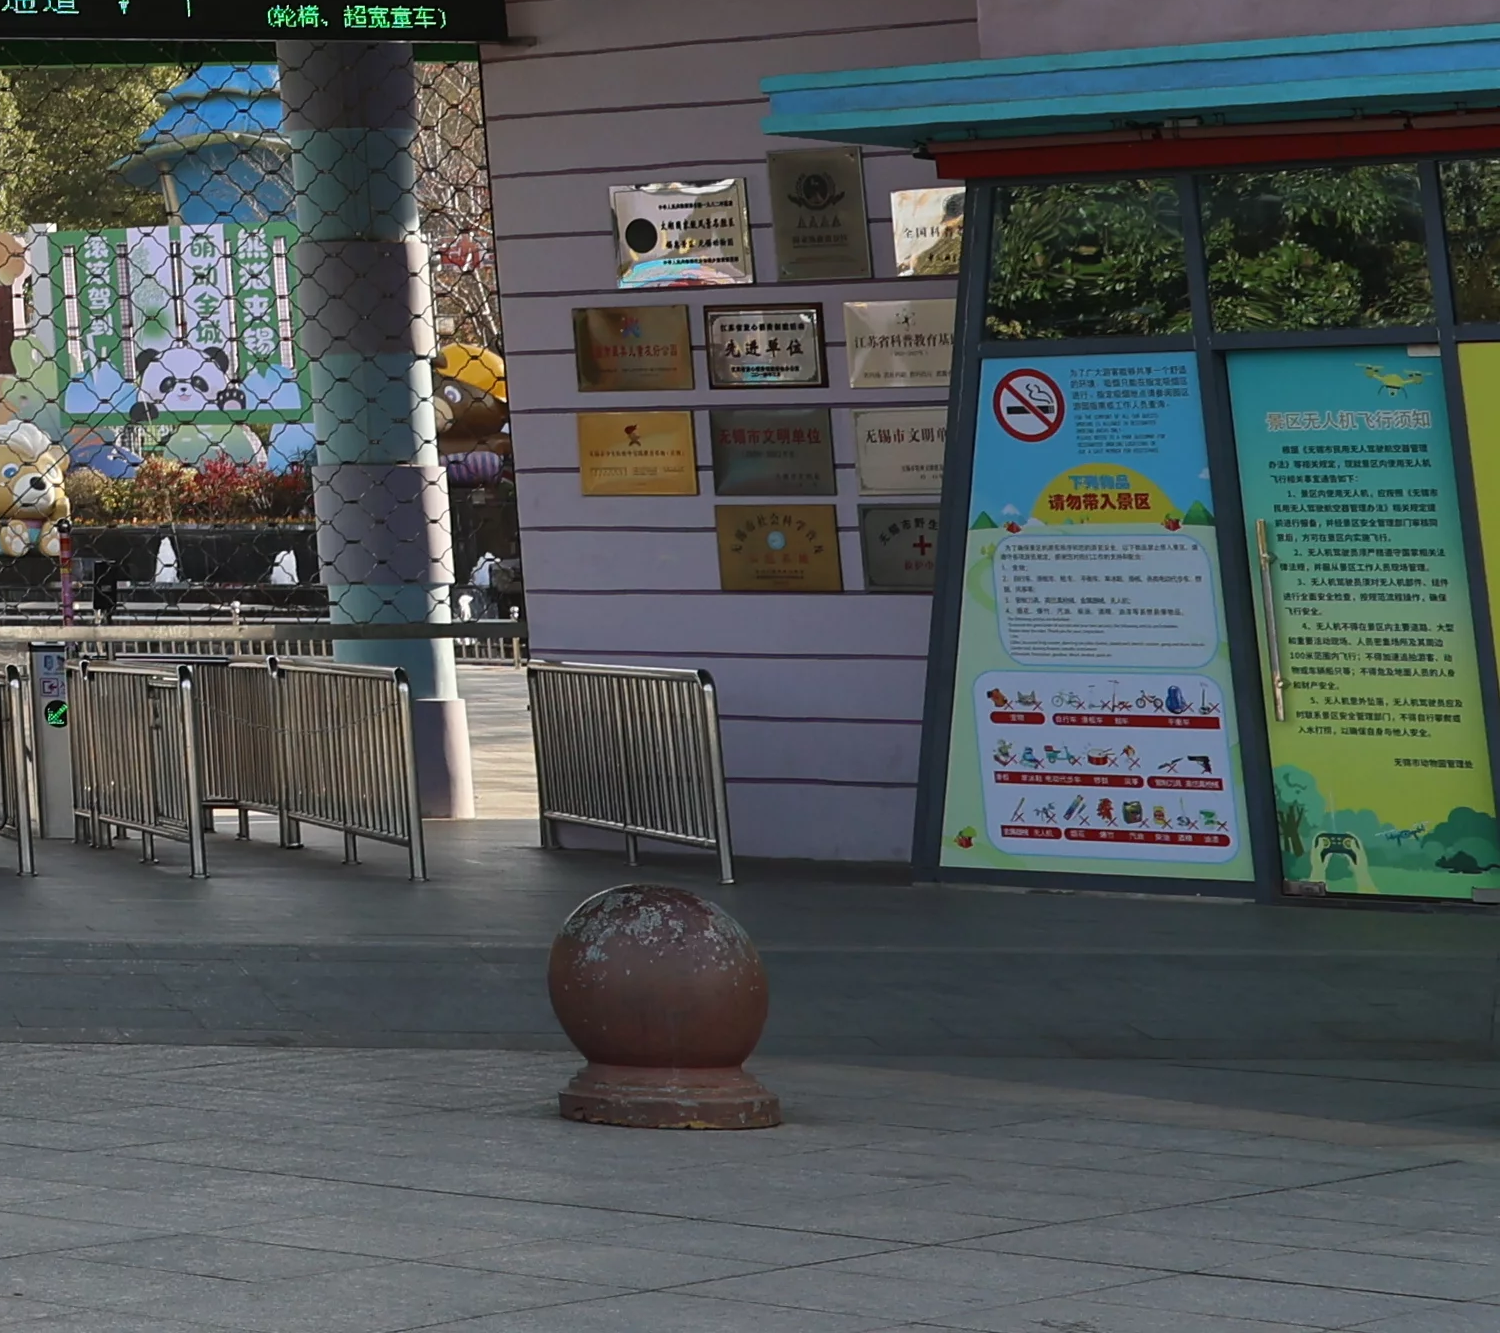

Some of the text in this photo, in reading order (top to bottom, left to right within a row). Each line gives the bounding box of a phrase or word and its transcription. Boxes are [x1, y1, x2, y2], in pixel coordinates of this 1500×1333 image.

[190, 234, 223, 345] 萌动全城
[237, 228, 275, 355] 熊猫来锡
[724, 338, 804, 358] 先进单位
[1266, 409, 1431, 431] 景区无人机飞行须知
[717, 427, 822, 445] 无锡市文明单位
[1068, 474, 1131, 490] 下列物品
[1048, 493, 1151, 510] 请勿带入景区
[1394, 758, 1473, 769] 无锡市动物园管理处
